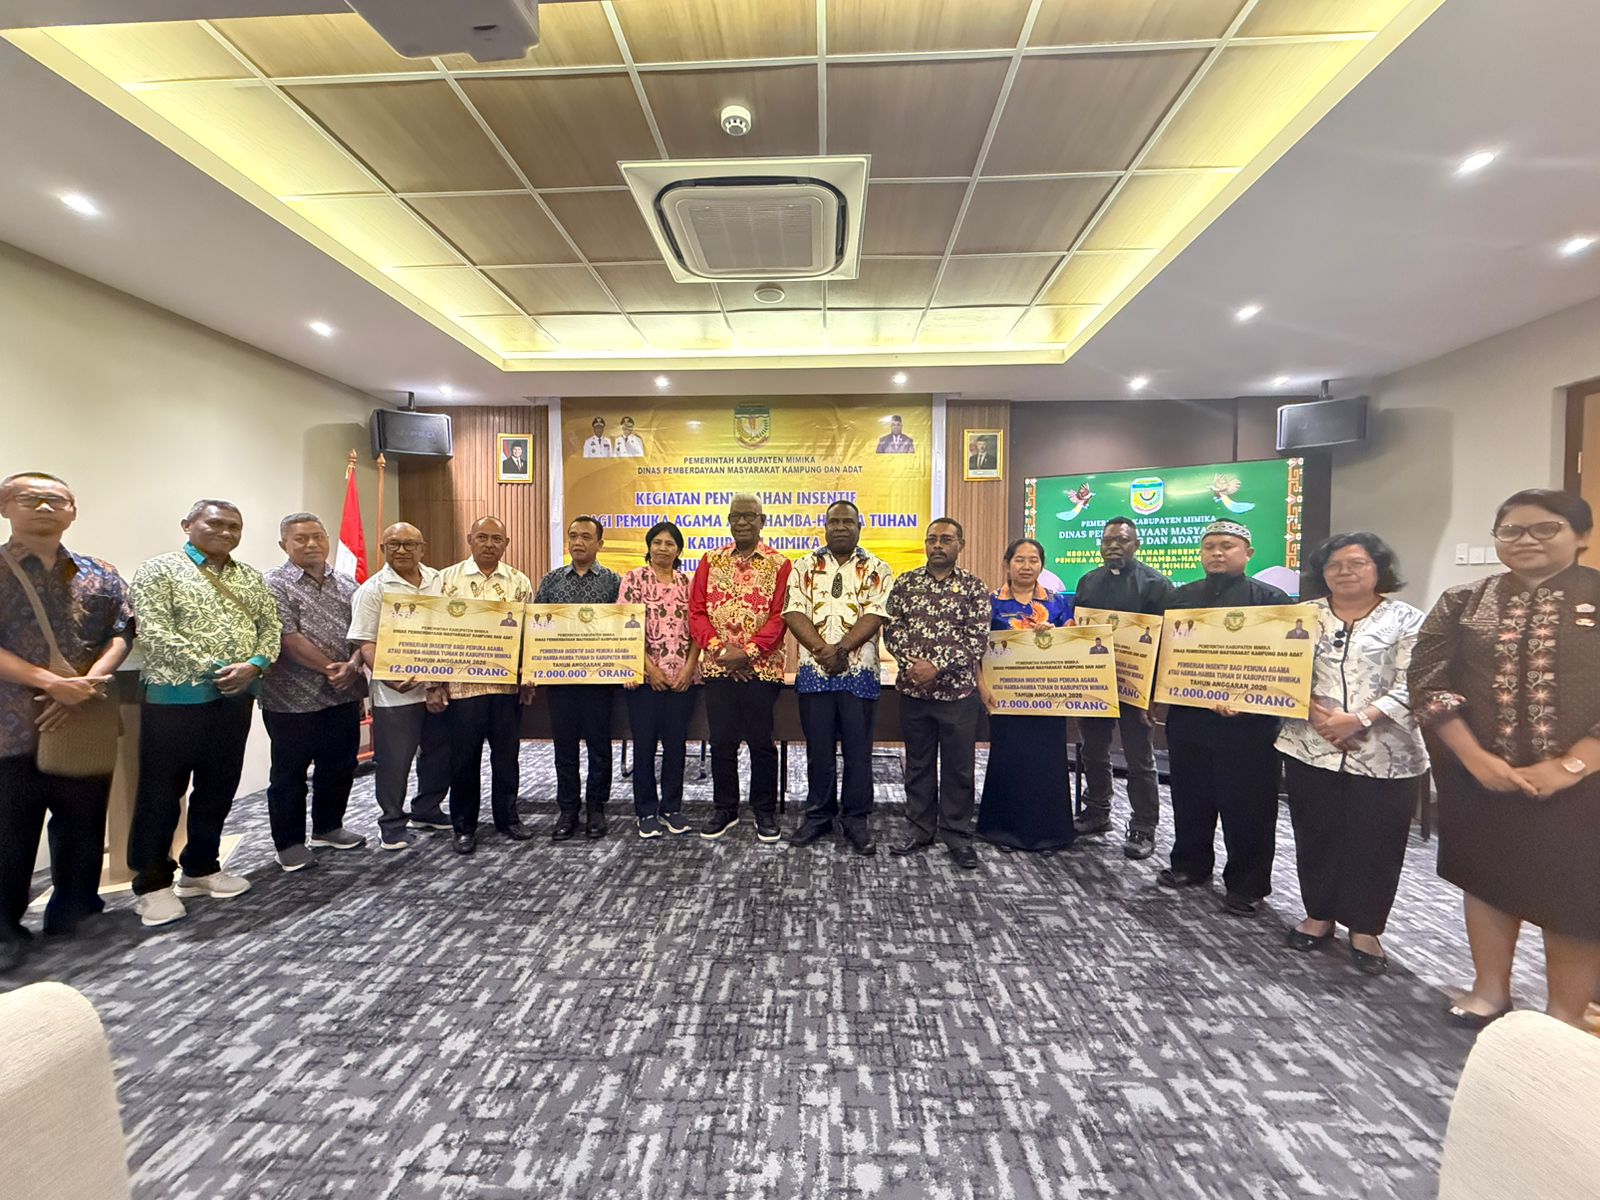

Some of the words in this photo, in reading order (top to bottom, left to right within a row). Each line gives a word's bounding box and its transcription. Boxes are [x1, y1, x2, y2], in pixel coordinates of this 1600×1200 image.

[684, 456, 734, 465] PEMERINTAH
[736, 456, 783, 464] KABUPATEN
[638, 466, 661, 475] DINAS
[663, 466, 725, 475] PEMBERDAYAAN
[727, 466, 780, 474] MASYARAKAT
[782, 466, 822, 474] KAMPUNG
[636, 492, 700, 504] KEGIATAN
[796, 492, 856, 504] INSENTIF
[616, 514, 668, 528] PEMUKA
[675, 514, 722, 528] AGAMA
[870, 514, 916, 526] TUHAN
[1059, 530, 1086, 538] DINAS
[768, 537, 820, 550] MIMIKA
[1146, 536, 1168, 544] DAN
[1170, 536, 1200, 544] ADAT
[390, 664, 454, 675] 12.000.000
[467, 667, 508, 676] ORANG
[534, 670, 587, 678] 12.000.000
[598, 669, 634, 677] ORANG
[1169, 687, 1229, 701] 12.000.000
[1244, 693, 1295, 708] ORANG
[997, 700, 1052, 709] 12.000.000
[1065, 701, 1108, 710] ORANG
